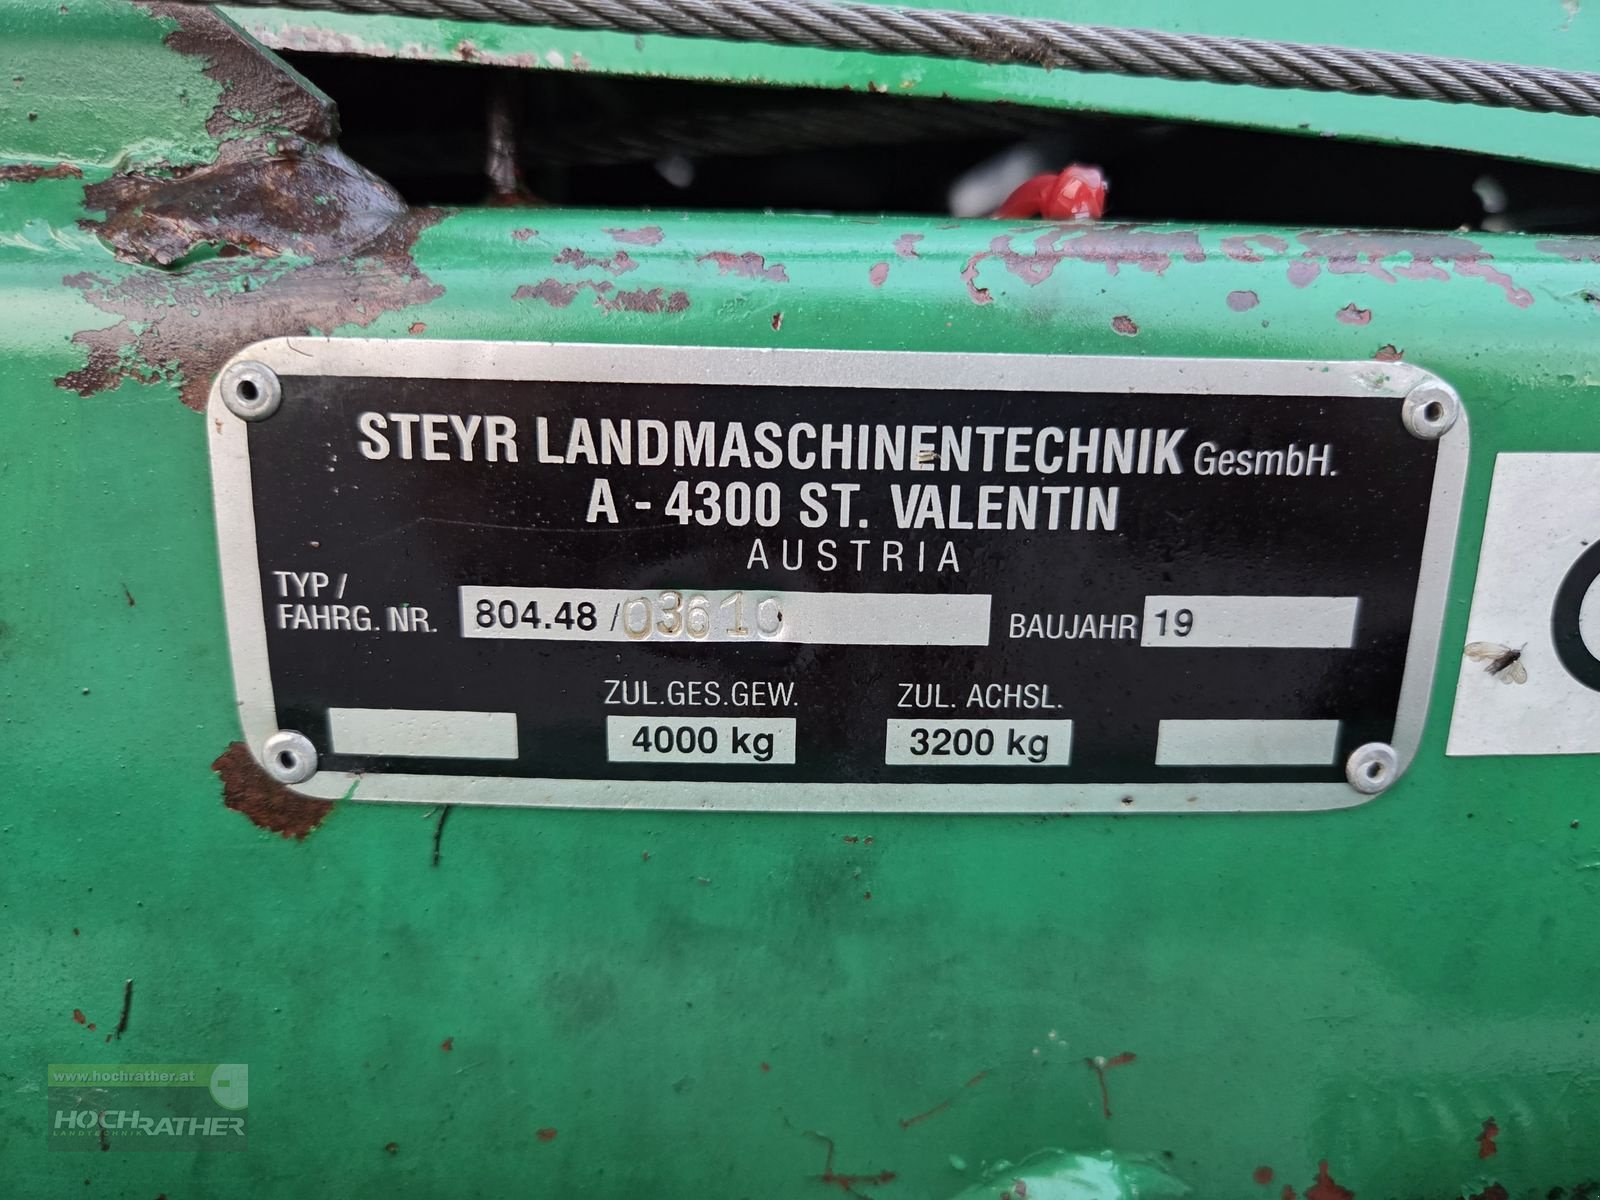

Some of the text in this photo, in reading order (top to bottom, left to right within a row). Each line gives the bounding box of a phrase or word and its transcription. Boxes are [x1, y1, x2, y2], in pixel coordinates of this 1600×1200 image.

[358, 412, 1336, 476] STEYR LANDMASCHINENTECHNIK GesmbH.
[586, 479, 618, 524] A
[665, 481, 780, 526] 4300
[800, 482, 867, 528] ST.
[891, 484, 1118, 530] VALENTIN
[747, 539, 959, 572] AUSTRIA
[274, 571, 328, 597] TYP
[278, 604, 437, 632] FAHRG. NR.
[1010, 614, 1136, 639] BAUJAHR
[1156, 609, 1193, 636] 19
[605, 680, 797, 706] ZUL.GES.GEW.
[898, 684, 1062, 708] ZUL. ACHSL.
[633, 726, 774, 762] 4000 kg
[910, 728, 1049, 763] 3200 kg
